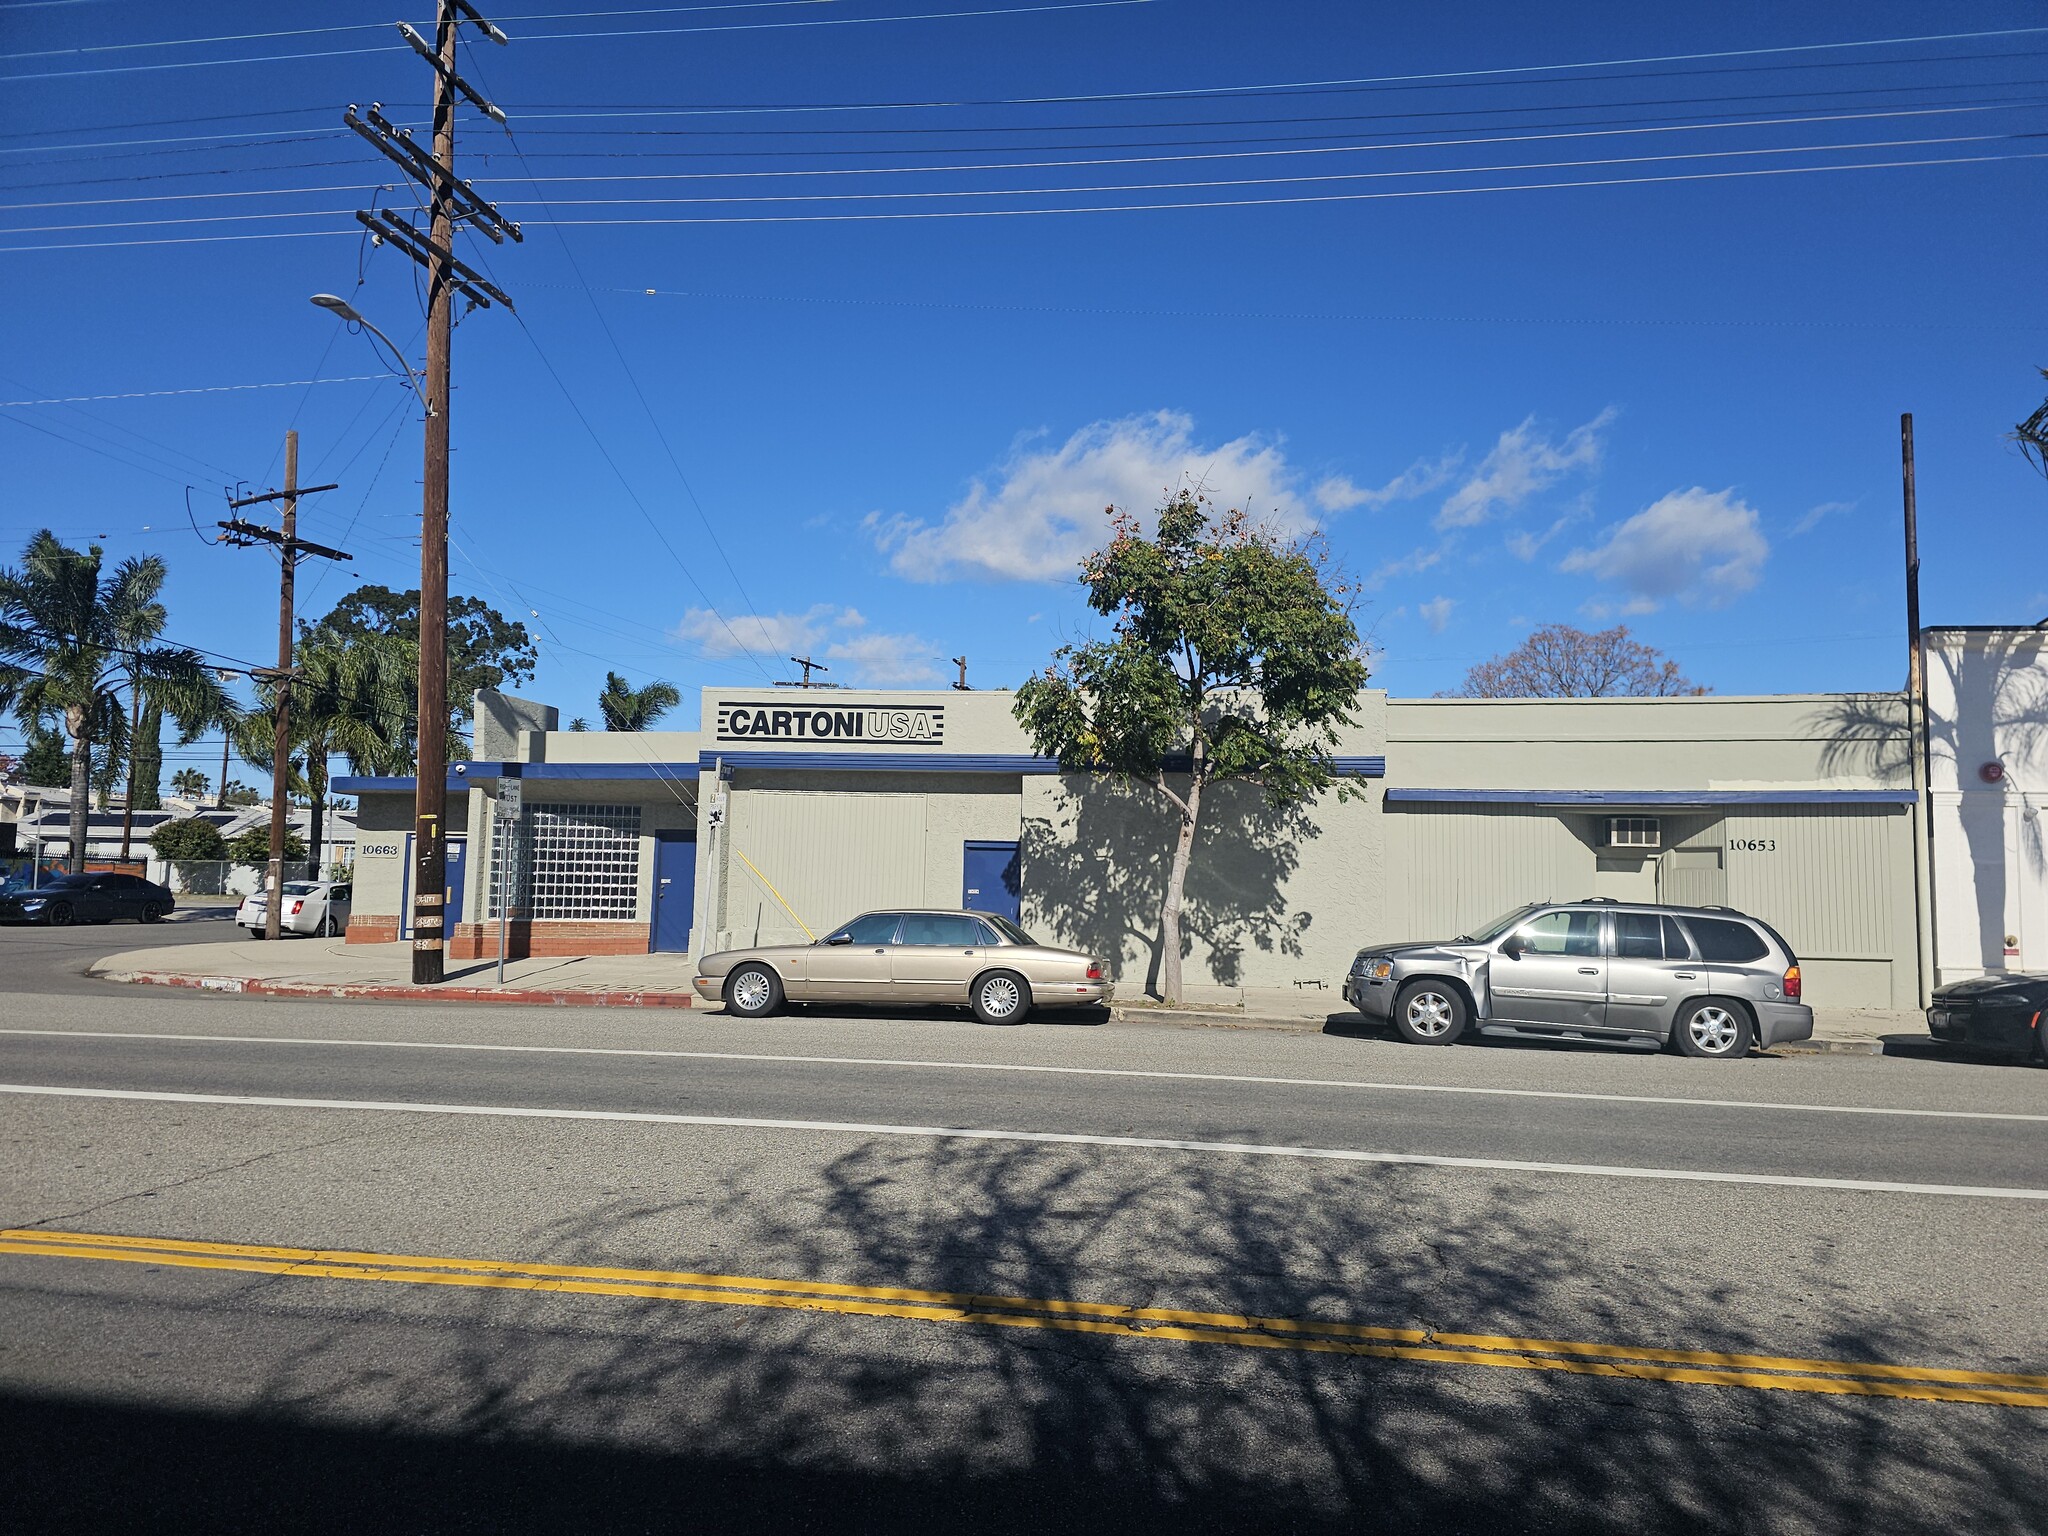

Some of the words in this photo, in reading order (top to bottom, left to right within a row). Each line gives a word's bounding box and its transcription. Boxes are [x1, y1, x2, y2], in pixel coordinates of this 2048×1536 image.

[730, 709, 863, 737] CARTONI
[868, 712, 931, 739] USA
[362, 845, 398, 855] 10663
[1729, 838, 1776, 851] 10653
